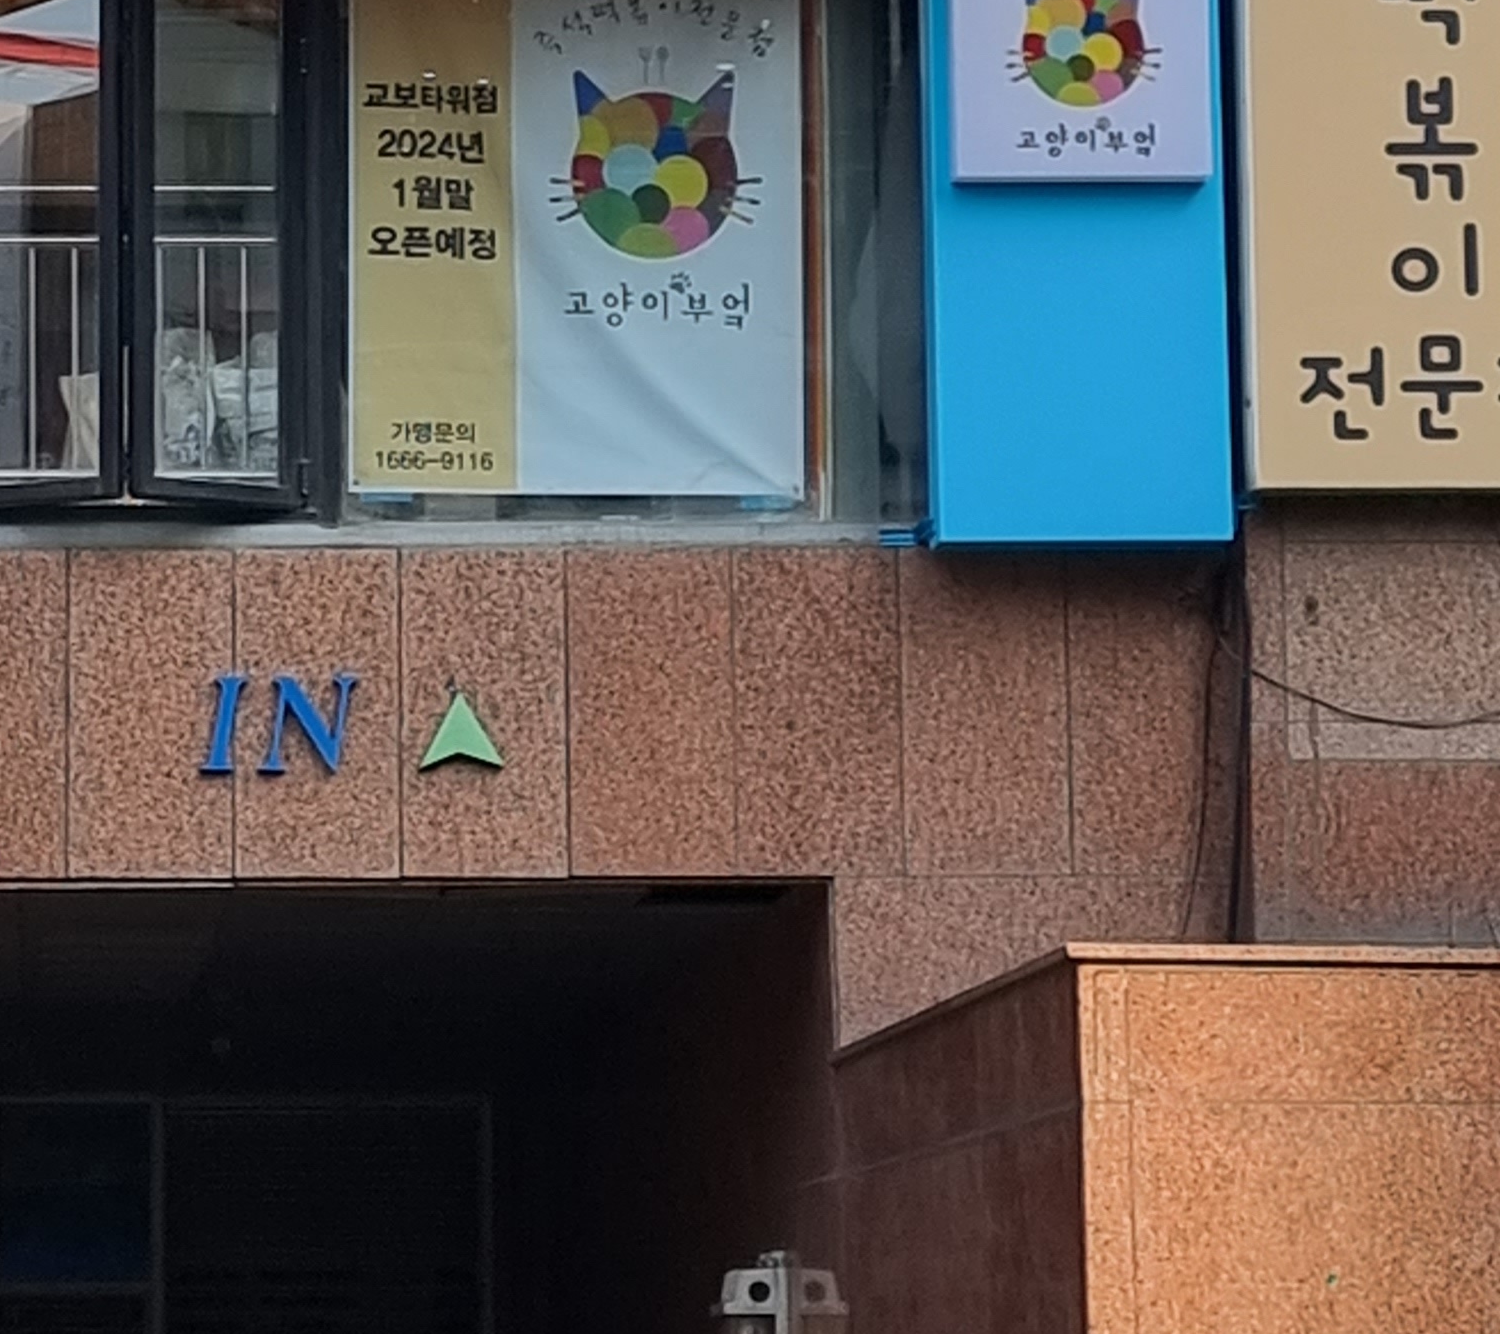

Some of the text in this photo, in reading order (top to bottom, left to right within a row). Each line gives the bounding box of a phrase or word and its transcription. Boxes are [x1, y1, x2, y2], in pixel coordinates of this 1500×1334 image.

[363, 82, 498, 115] 교보타워점
[377, 128, 485, 164] 2024년
[368, 226, 496, 260] 오픈예정
[1299, 334, 1500, 442] 전문
[375, 450, 494, 471] 1666-9116
[198, 671, 358, 775] IN
